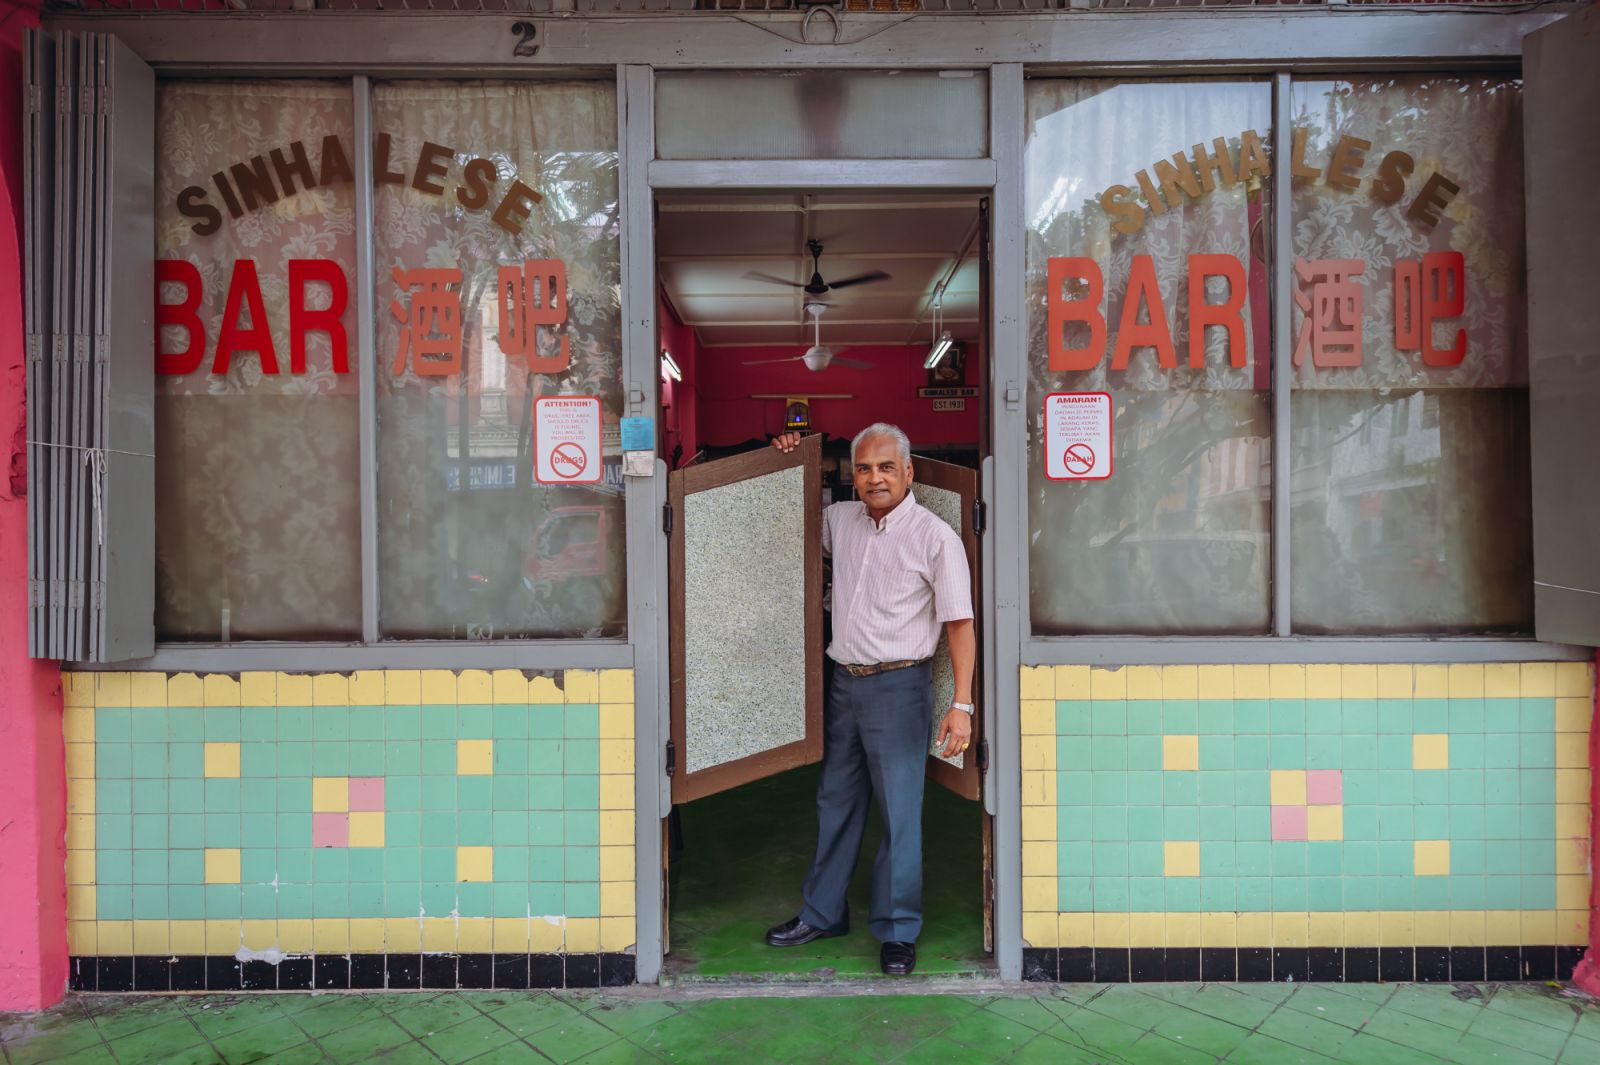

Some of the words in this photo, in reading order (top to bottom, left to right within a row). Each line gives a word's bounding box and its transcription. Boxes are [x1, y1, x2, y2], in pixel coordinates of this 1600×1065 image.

[510, 21, 540, 57] 2
[176, 132, 543, 238] SINHALESE
[1100, 128, 1460, 234] SINHALESE
[154, 258, 351, 376] BAR
[391, 258, 570, 376] 酒吧
[1047, 253, 1248, 372] BAR
[1293, 251, 1468, 368] 酒吧
